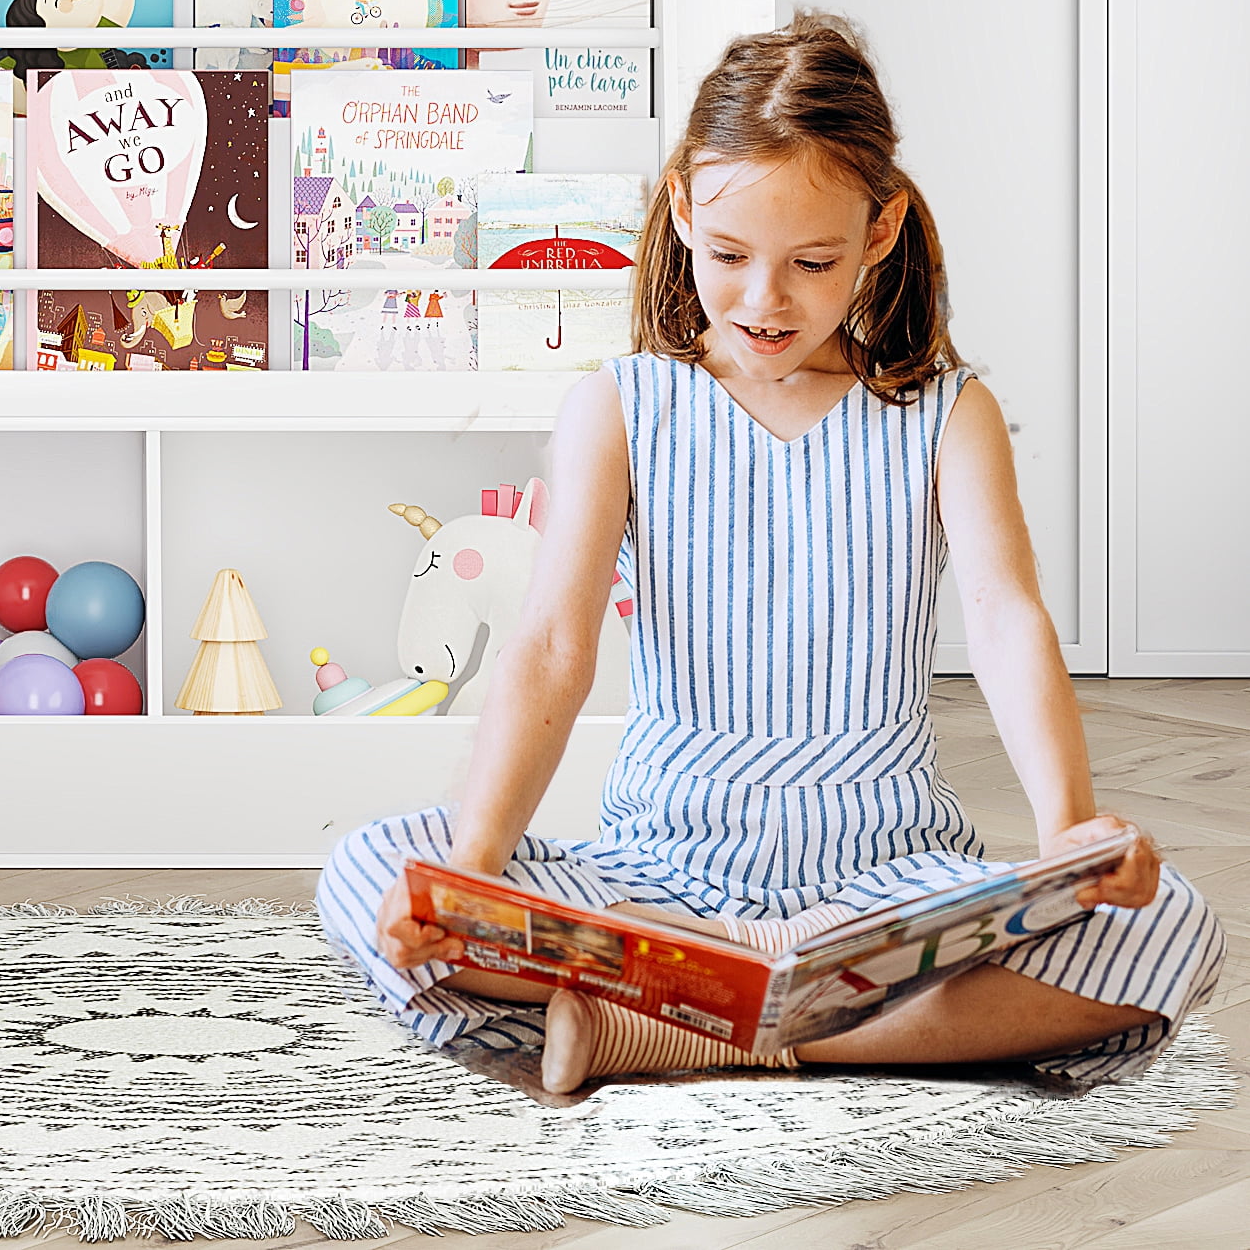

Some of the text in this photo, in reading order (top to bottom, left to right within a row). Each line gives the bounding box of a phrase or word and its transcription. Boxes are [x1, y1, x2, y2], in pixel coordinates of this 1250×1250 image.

[544, 48, 639, 73] Un chico de
[104, 82, 133, 103] and
[401, 85, 420, 97] THE
[548, 70, 640, 100] pelo largo
[342, 100, 479, 125] ORPHAN BAND
[67, 98, 184, 154] AWAY
[118, 135, 142, 150] we
[355, 129, 465, 150] of SPRINGDALE
[104, 146, 165, 182] GO
[546, 247, 576, 259] RED
[518, 303, 556, 311] Christina
[584, 300, 622, 308] Gonzalez
